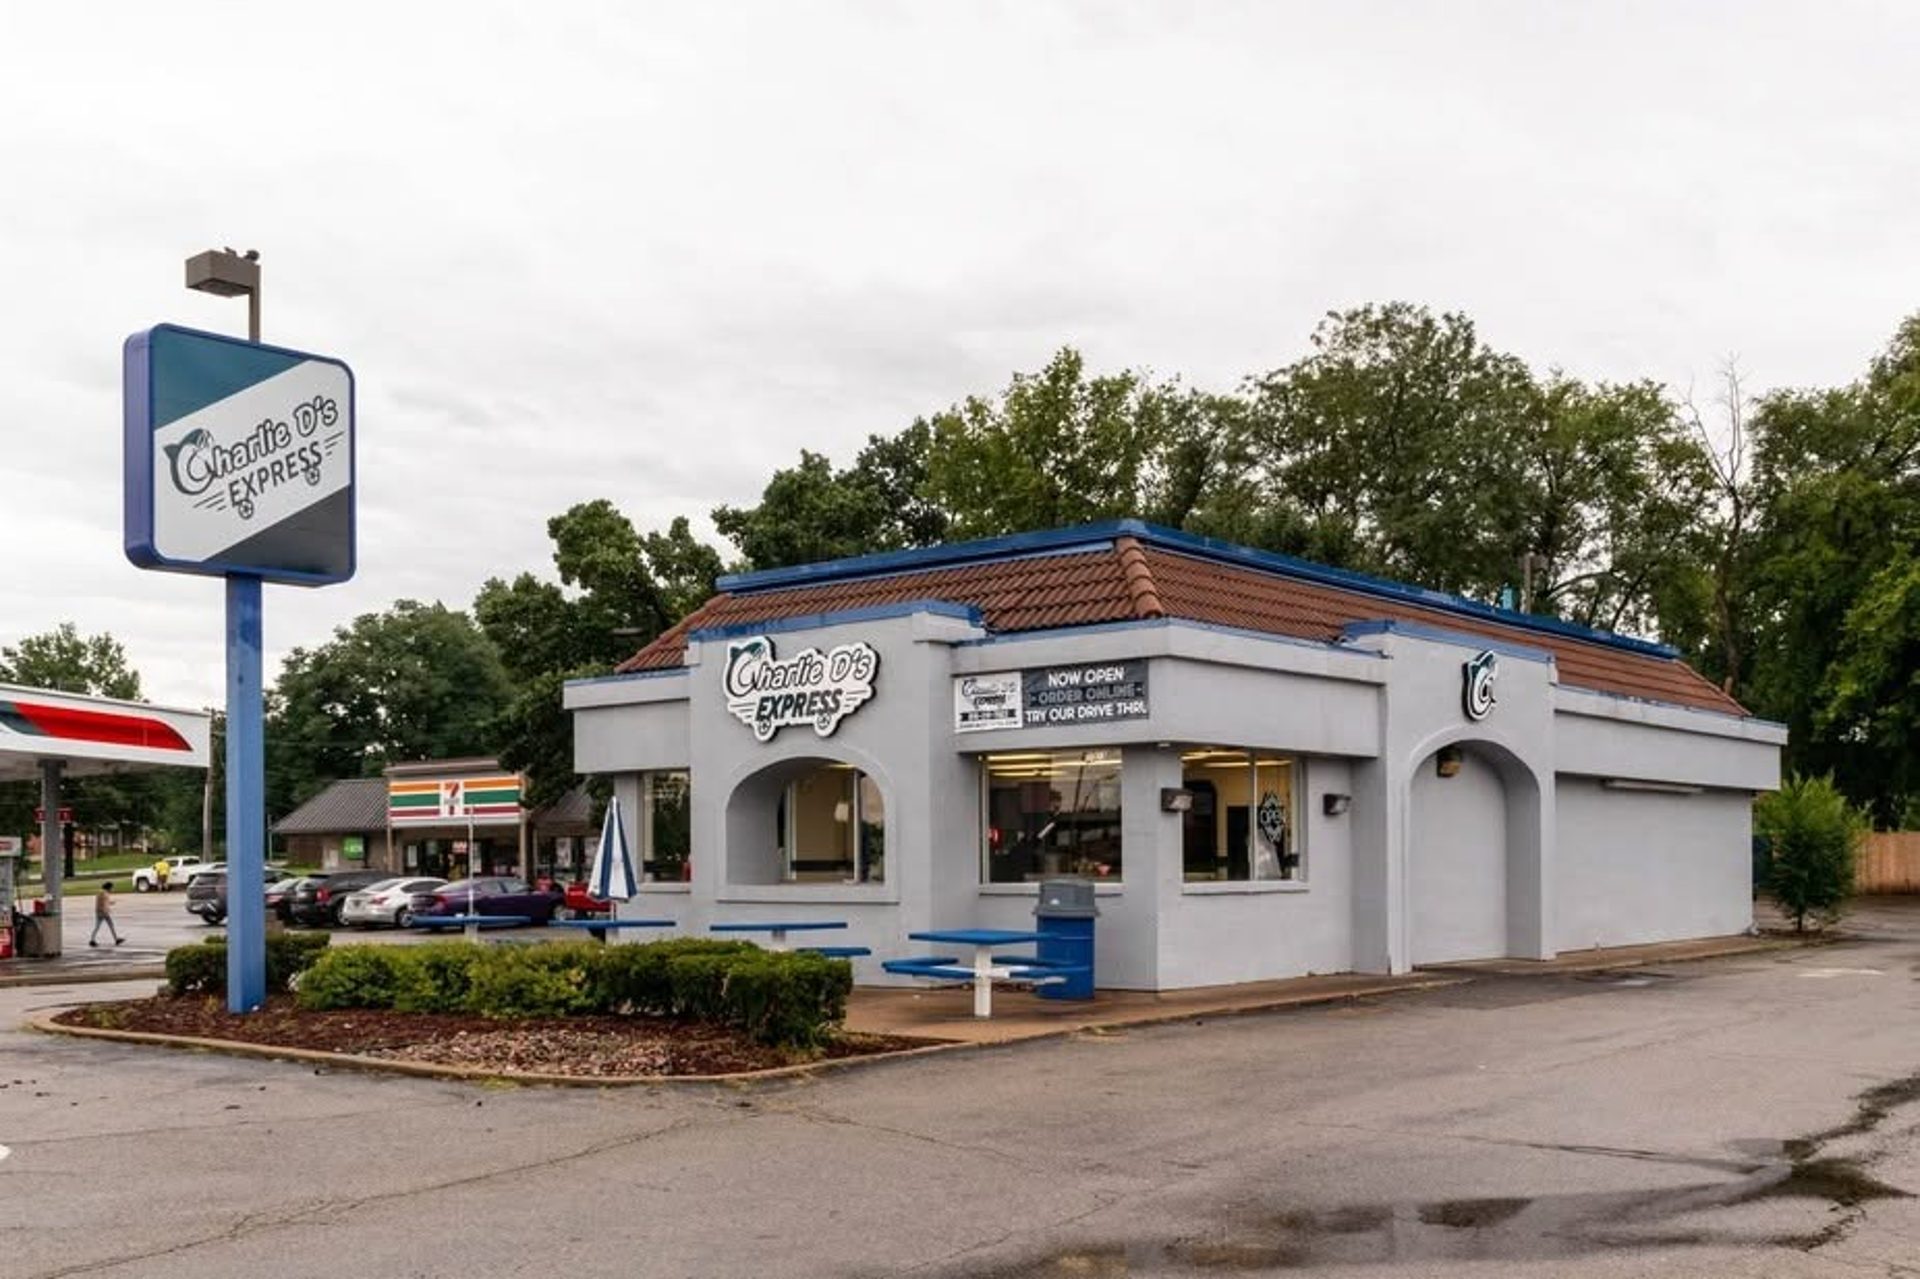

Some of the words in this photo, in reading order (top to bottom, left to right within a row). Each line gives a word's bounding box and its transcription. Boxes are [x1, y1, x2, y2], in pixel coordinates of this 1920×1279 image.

[163, 418, 291, 496] Charlie
[293, 395, 339, 438] D's
[228, 440, 323, 509] EXPRESS
[727, 642, 824, 698] Charlie
[830, 648, 872, 683] D's
[1048, 670, 1082, 689] NOW
[1084, 666, 1125, 684] OPEN
[755, 687, 844, 722] EXPRESS
[1038, 688, 1083, 705] ORDER
[1085, 683, 1135, 701] ONLINE
[1025, 709, 1047, 723] TRY
[1049, 706, 1076, 721] OUR
[1077, 703, 1114, 719] DRIVE
